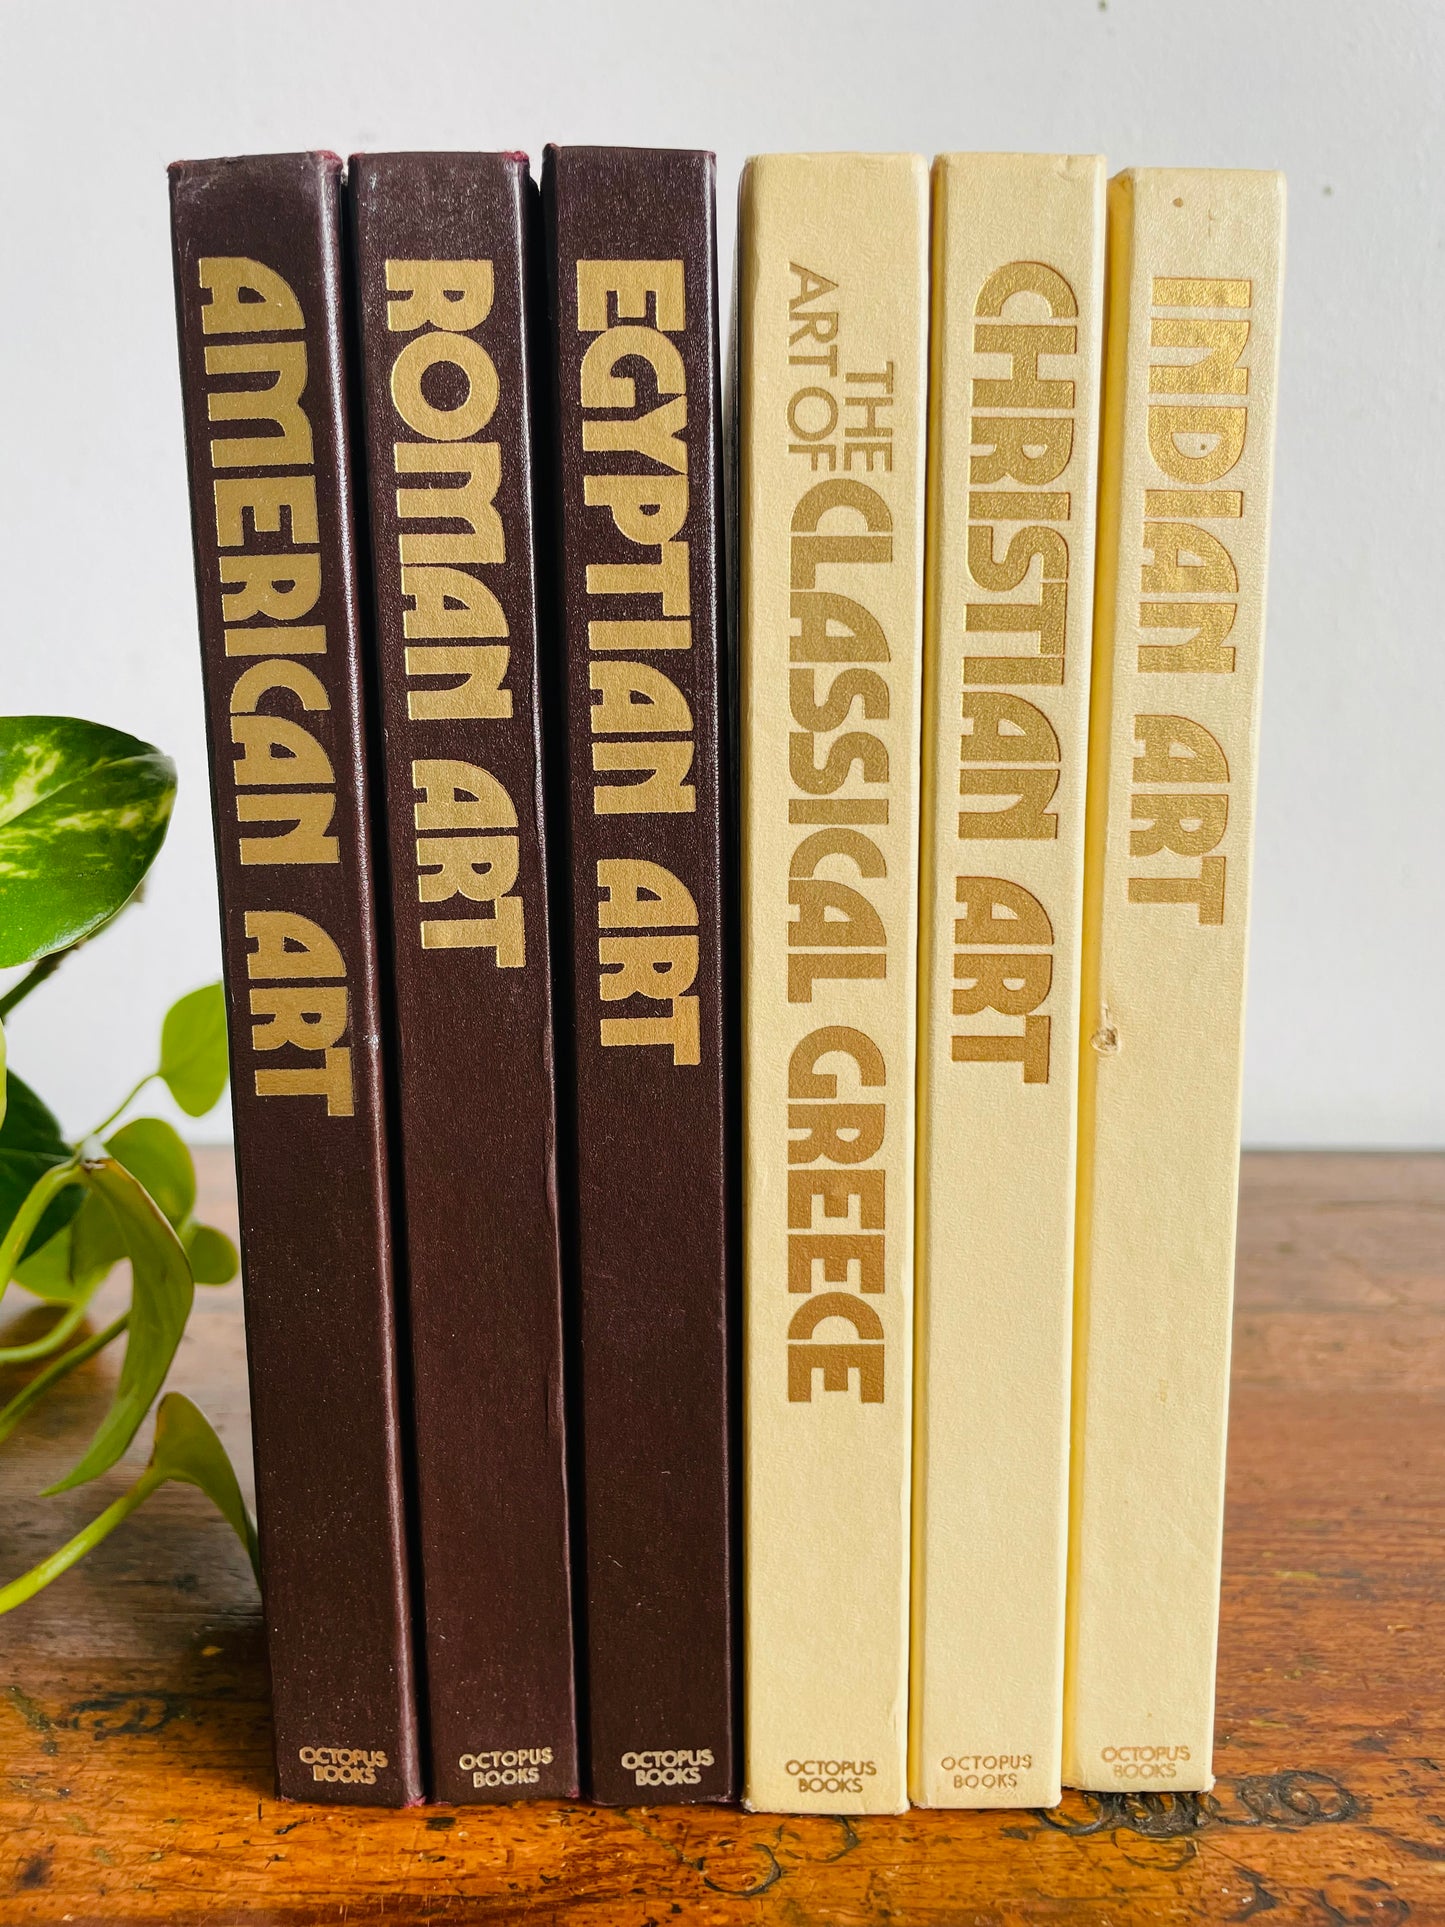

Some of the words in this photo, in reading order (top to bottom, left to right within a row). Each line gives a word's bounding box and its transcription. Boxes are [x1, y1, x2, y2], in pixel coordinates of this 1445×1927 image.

[787, 261, 839, 377] ART
[787, 386, 836, 473] OF
[843, 361, 894, 473] THE
[384, 259, 514, 720] ROMAN
[1137, 278, 1252, 673] INDIAN
[197, 257, 340, 866] AMERICAN
[575, 259, 697, 815] EGYPTIAN
[958, 260, 1078, 839] CHRISTIAN
[788, 477, 893, 1004] CLASSICAL
[410, 758, 527, 969] ART
[1128, 715, 1230, 924] ART
[242, 908, 355, 1118] ART
[596, 858, 702, 1067] ART
[951, 877, 1055, 1084] ART
[788, 1024, 886, 1403] GREECE
[300, 1746, 388, 1768] OCTOPUS
[313, 1765, 377, 1785] BOOKS
[459, 1746, 553, 1771] OCTOPUS
[473, 1767, 540, 1787] BOOKS
[621, 1748, 715, 1769] OCTOPUS
[635, 1767, 701, 1786] BOOKS
[785, 1760, 876, 1776] OCTOPUS
[799, 1777, 863, 1793] BOOKS
[941, 1755, 1032, 1771] OCTOPUS
[953, 1773, 1018, 1789] BOOKS
[1100, 1745, 1190, 1762] OCTOPUS
[1113, 1762, 1177, 1779] BOOKS
